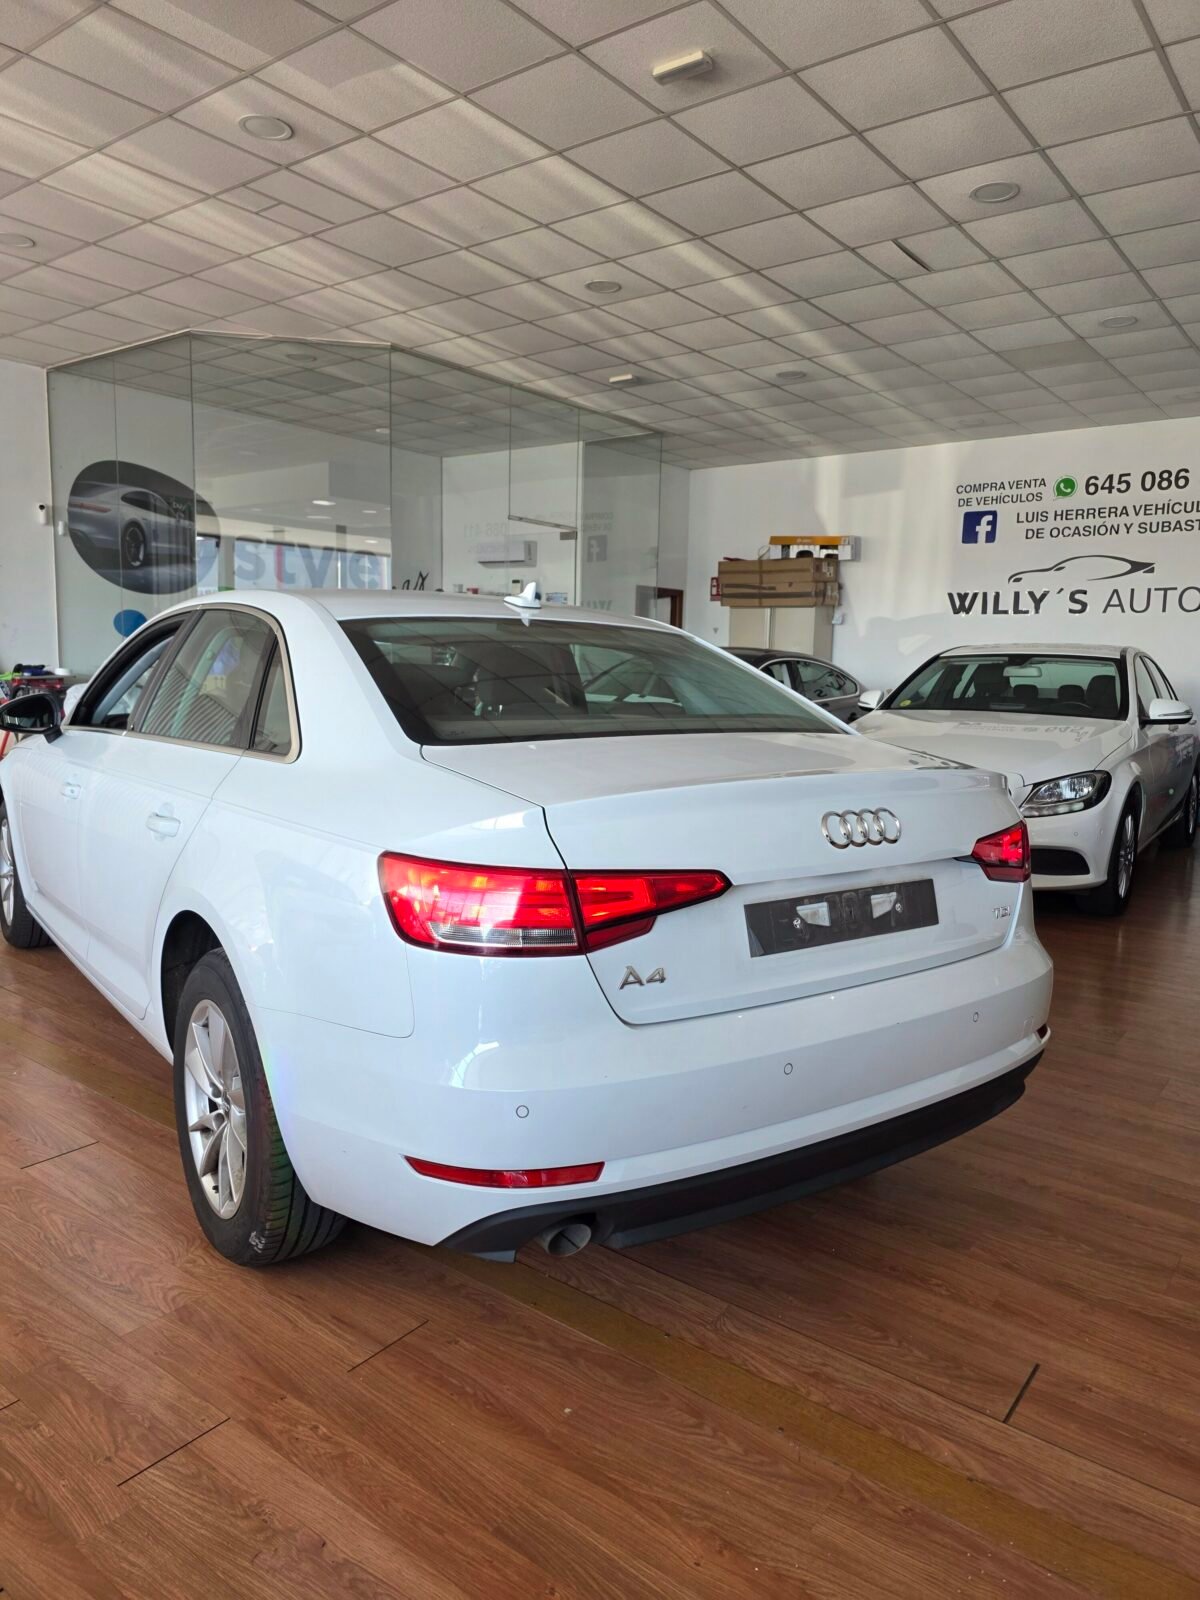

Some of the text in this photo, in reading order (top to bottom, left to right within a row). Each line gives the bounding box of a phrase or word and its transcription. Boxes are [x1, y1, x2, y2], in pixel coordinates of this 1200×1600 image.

[956, 478, 1047, 495] COMPRA VENTA
[1085, 468, 1190, 496] 645 086
[958, 492, 1043, 508] DE VEHÍCULOS
[1016, 510, 1049, 524] LUIS
[1053, 505, 1130, 522] HERRERA
[1025, 527, 1045, 540] DE
[1049, 521, 1120, 538] OCASIÓN
[1123, 522, 1134, 535] Y
[1101, 586, 1200, 614] AUTO
[619, 965, 667, 990] A4
